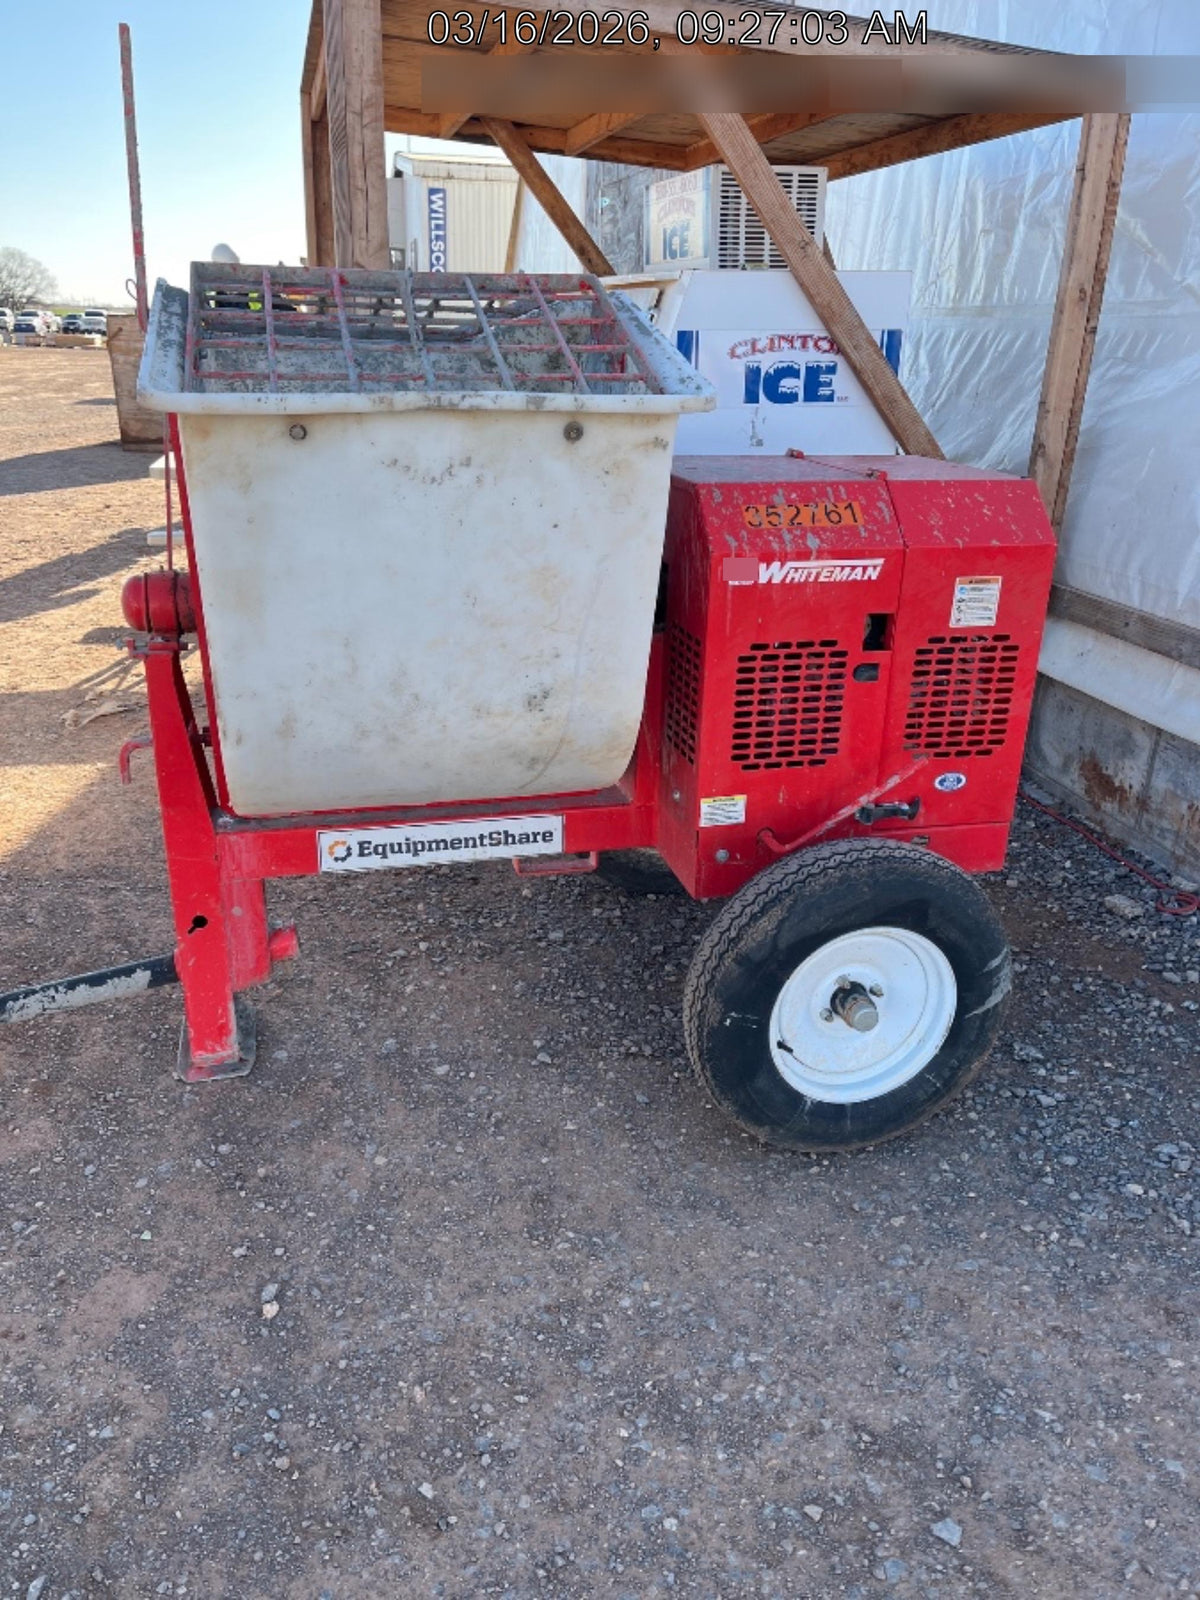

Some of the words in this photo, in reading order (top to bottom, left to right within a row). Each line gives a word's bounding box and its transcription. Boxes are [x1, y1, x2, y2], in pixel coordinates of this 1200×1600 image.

[662, 221, 690, 260] ICE
[728, 333, 843, 359] CLINTO
[743, 360, 838, 404] ICE
[744, 502, 858, 528] 352761
[758, 558, 885, 584] WHITEMAN
[357, 829, 554, 859] EquipmentShare
